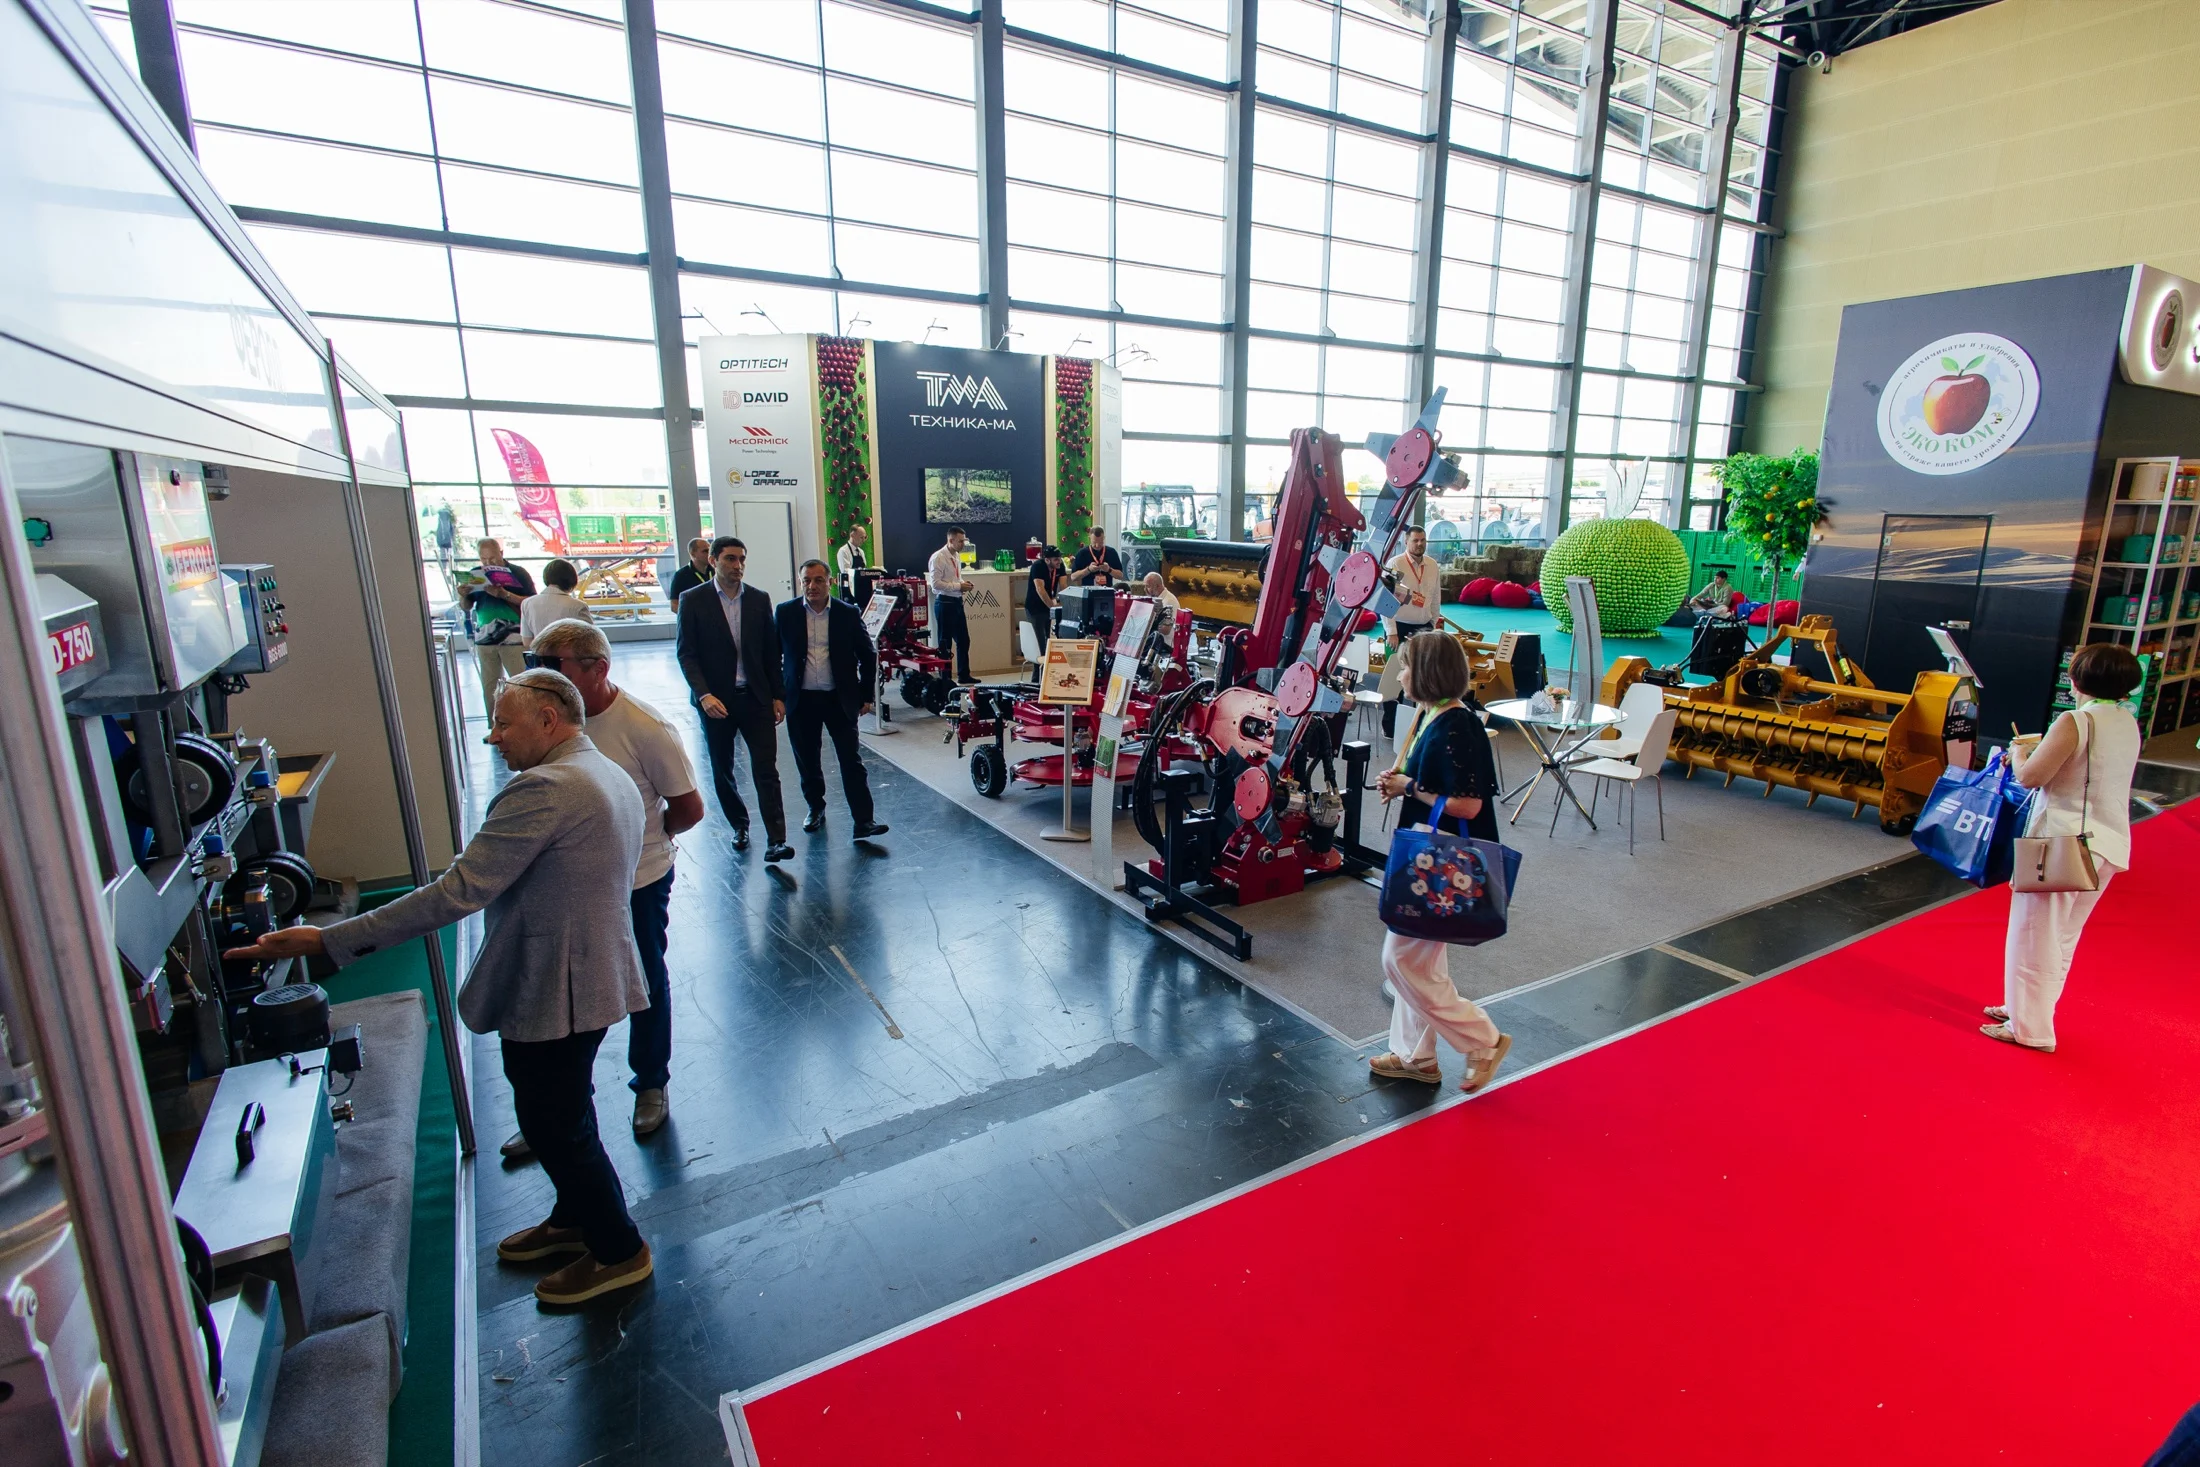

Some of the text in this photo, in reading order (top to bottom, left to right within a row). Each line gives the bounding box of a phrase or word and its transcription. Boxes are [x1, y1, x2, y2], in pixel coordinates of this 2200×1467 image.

[719, 358, 789, 370] OPTITECH
[1903, 343, 1966, 379] агрохимикаты
[1979, 342, 2021, 369] удобрения
[743, 392, 789, 403] DAVID
[909, 414, 1017, 431] ТЕХНИКА-МА
[728, 437, 789, 445] McCORMICK
[1902, 423, 1996, 454] ЭКО КОМ
[1903, 450, 1932, 466] страже
[1974, 433, 2006, 461] урожая
[744, 470, 780, 478] LOPEZ
[753, 478, 798, 486] GARRIDO
